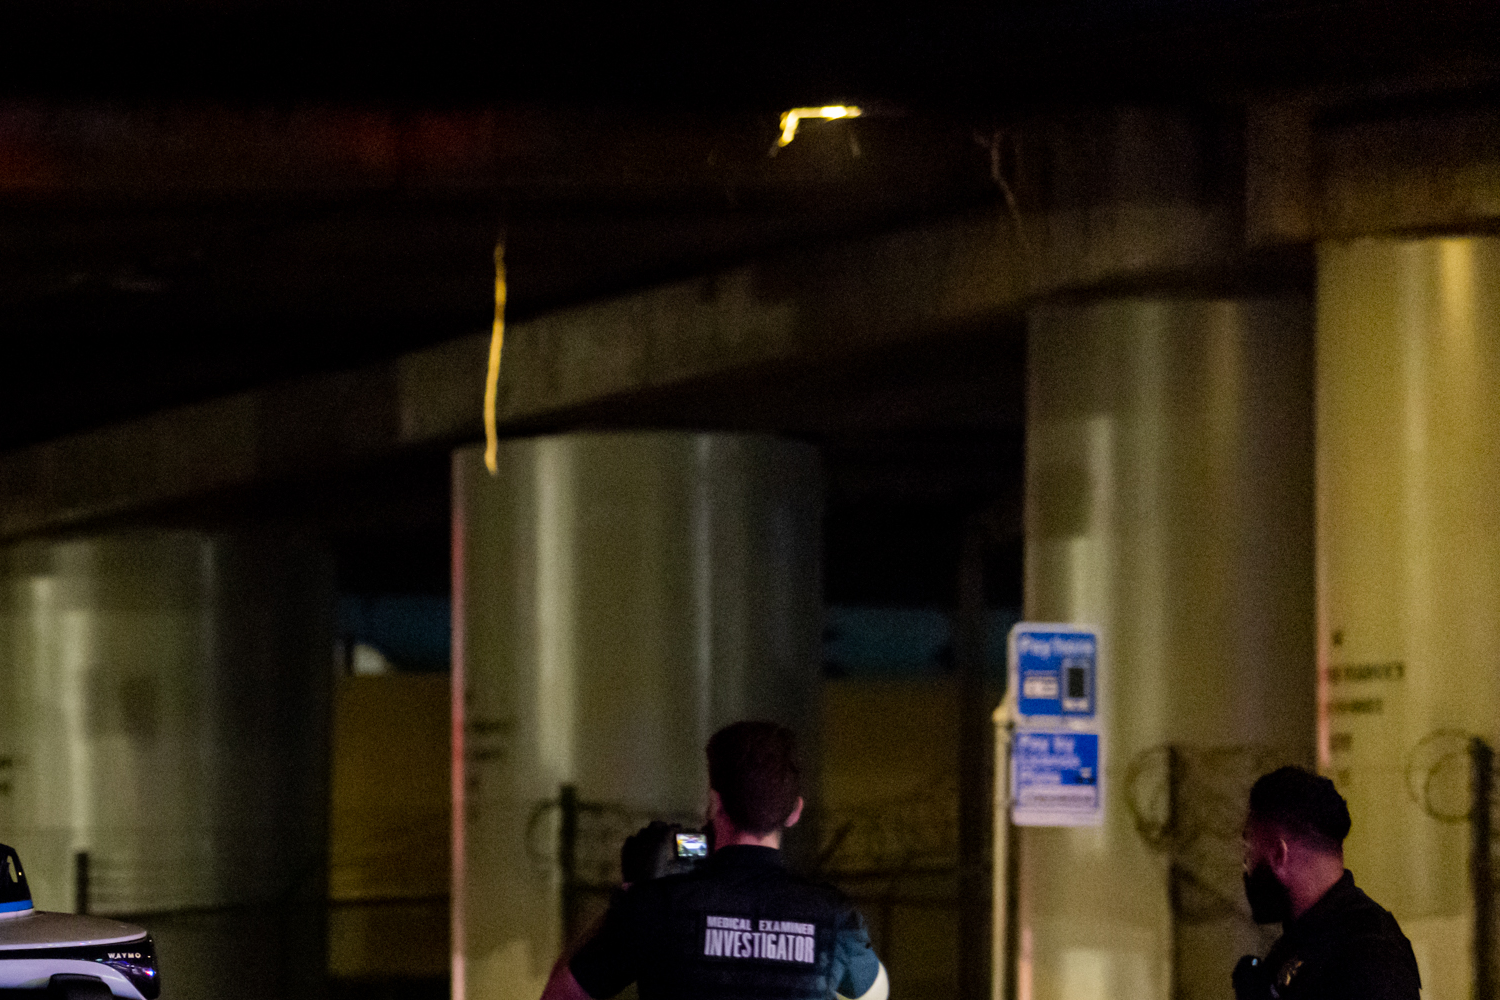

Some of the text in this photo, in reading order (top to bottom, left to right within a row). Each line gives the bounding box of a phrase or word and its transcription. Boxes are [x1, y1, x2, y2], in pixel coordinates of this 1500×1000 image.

[706, 915, 816, 936] MEDICAL EXAMINER
[704, 928, 816, 964] INVESTIGATOR
